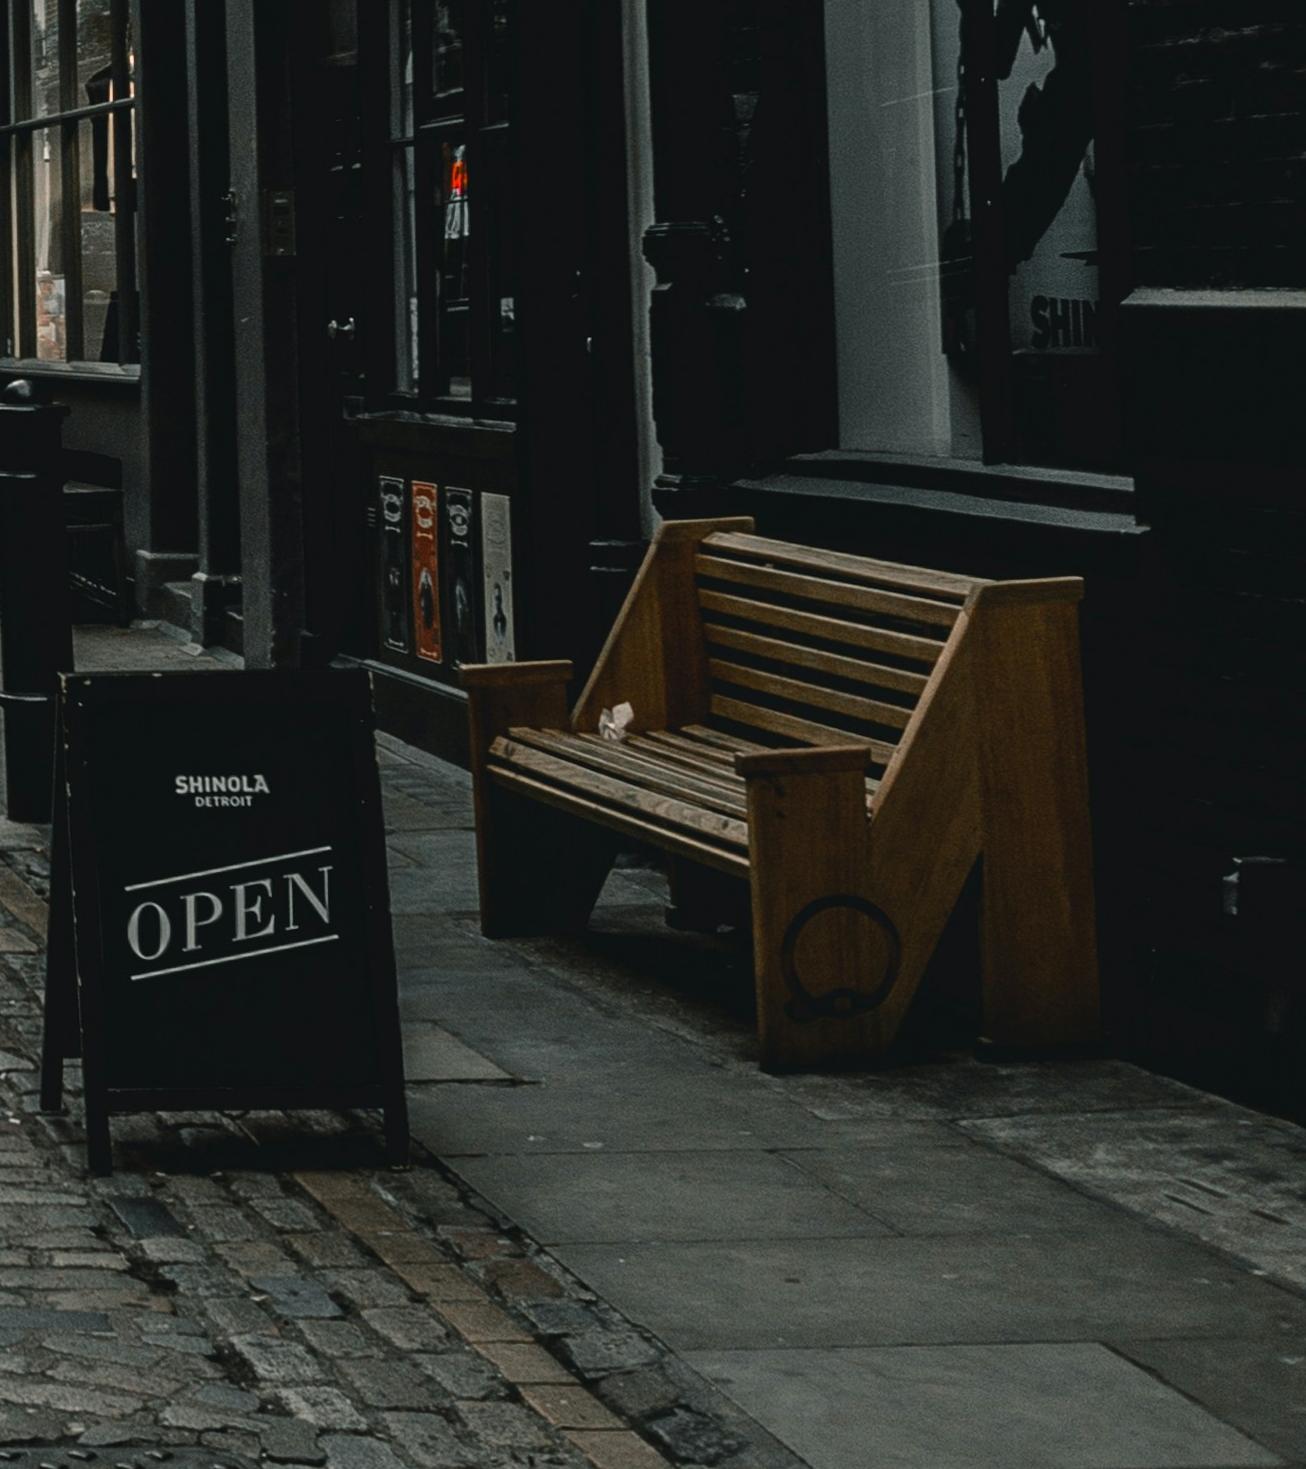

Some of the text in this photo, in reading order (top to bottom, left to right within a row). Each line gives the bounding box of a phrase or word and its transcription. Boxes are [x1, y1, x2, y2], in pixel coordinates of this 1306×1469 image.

[174, 774, 271, 795] SHINOLA
[194, 795, 253, 808] DETROIT
[127, 865, 334, 961] OPEN
